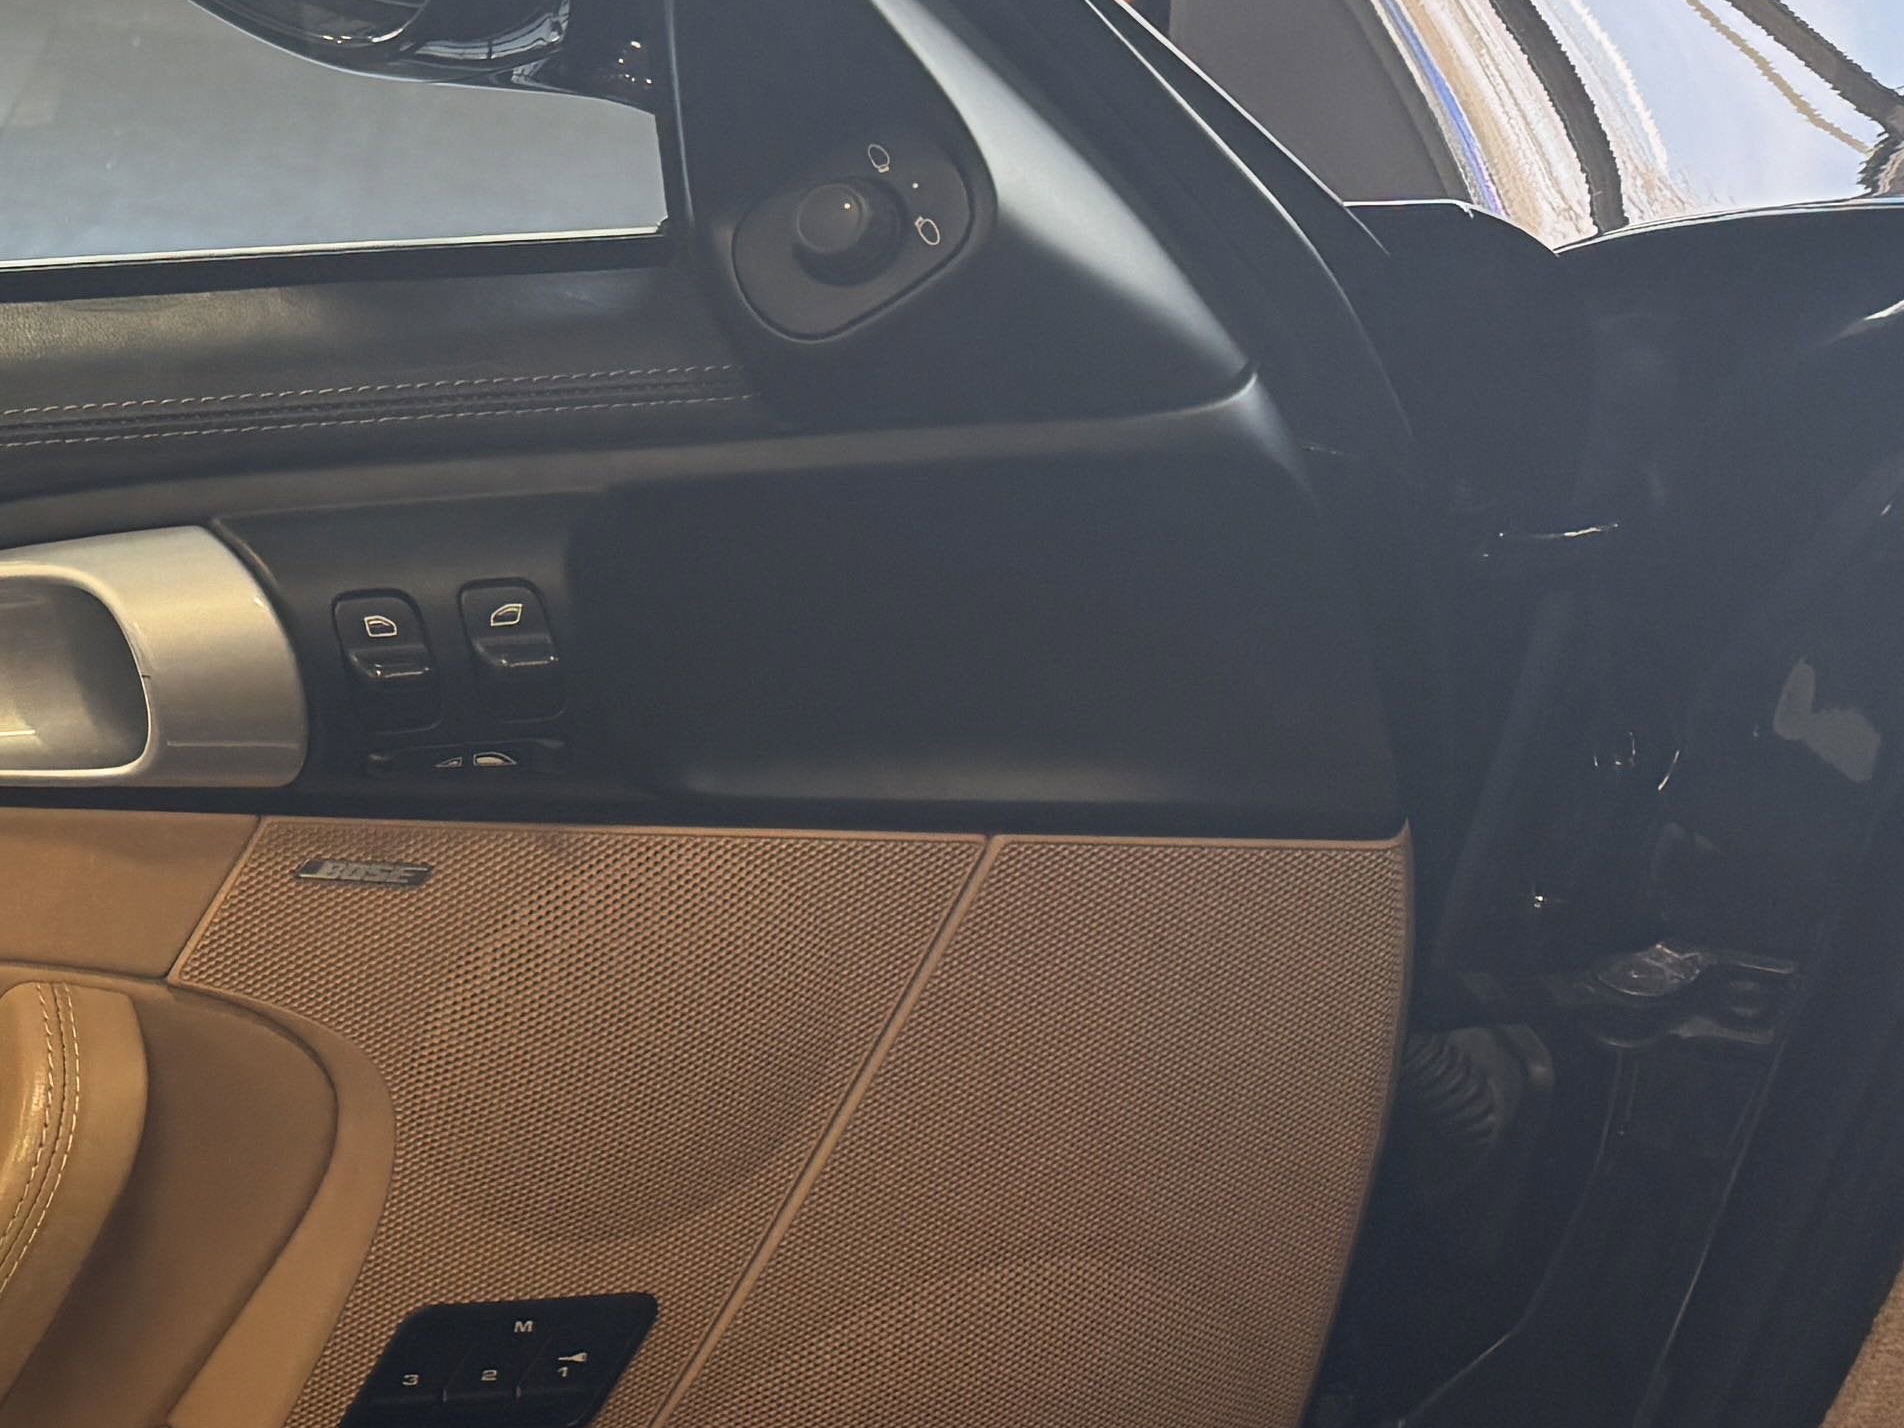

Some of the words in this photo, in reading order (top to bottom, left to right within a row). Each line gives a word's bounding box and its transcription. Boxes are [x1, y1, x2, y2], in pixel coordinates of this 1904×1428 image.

[513, 1319, 534, 1333] M
[402, 1373, 419, 1386] 3
[480, 1369, 498, 1382] 2
[556, 1366, 569, 1379] 1
